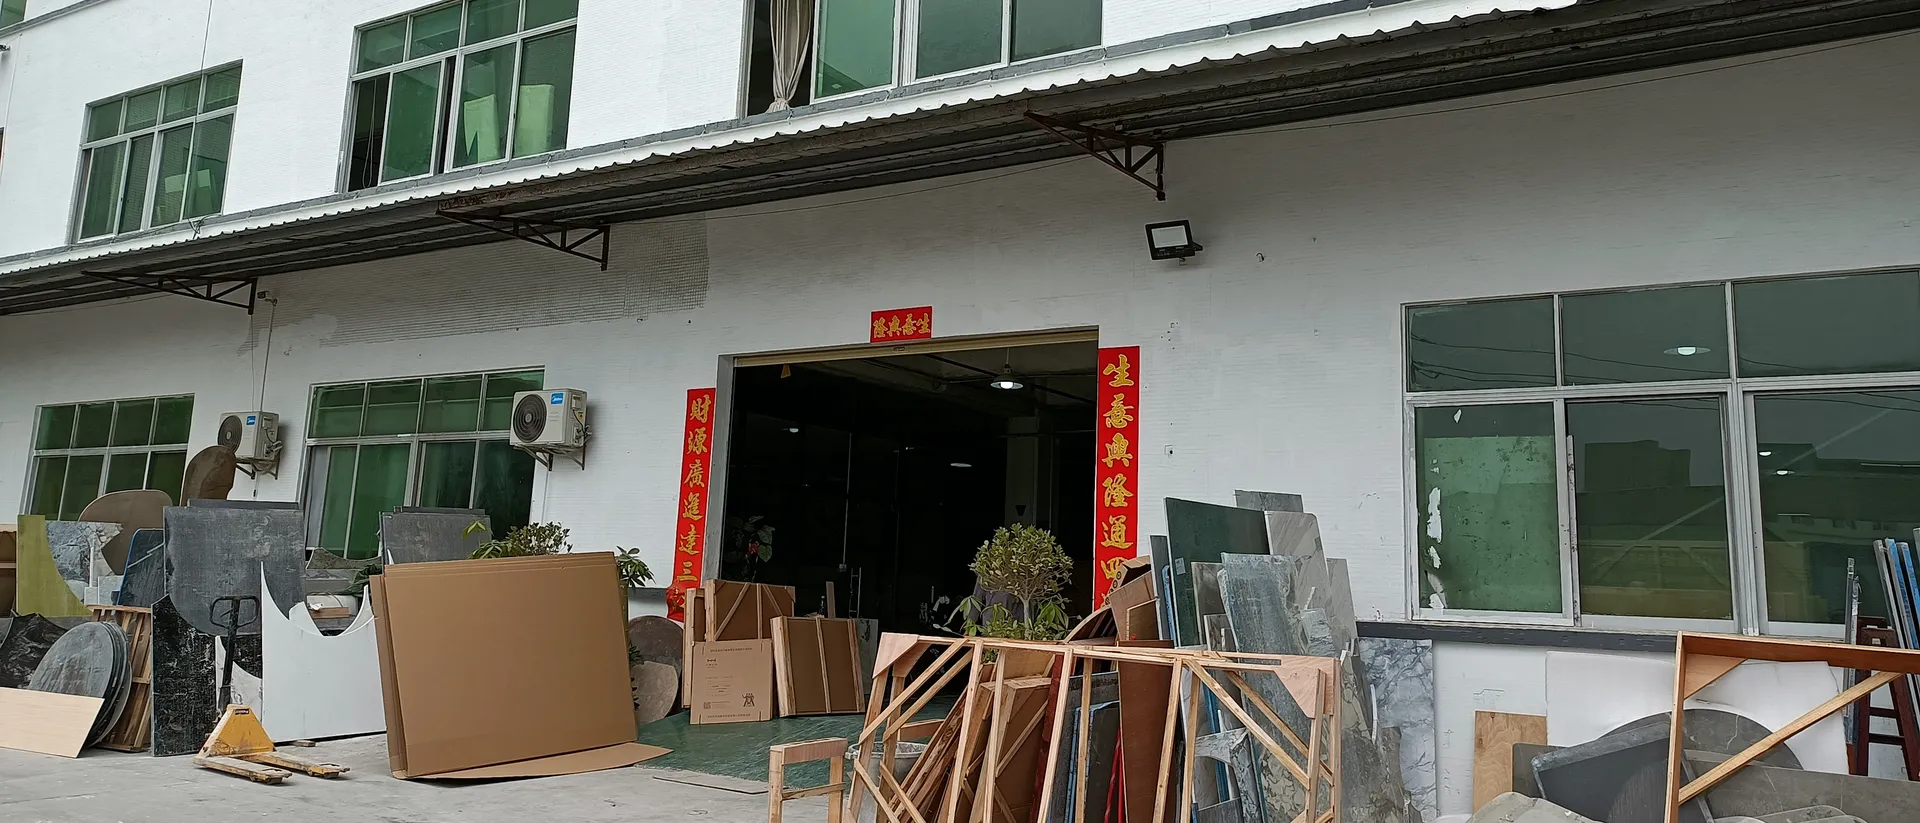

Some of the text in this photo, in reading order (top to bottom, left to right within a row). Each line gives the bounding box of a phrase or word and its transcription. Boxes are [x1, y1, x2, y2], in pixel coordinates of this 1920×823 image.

[1100, 353, 1135, 606] 生意興隆通四
